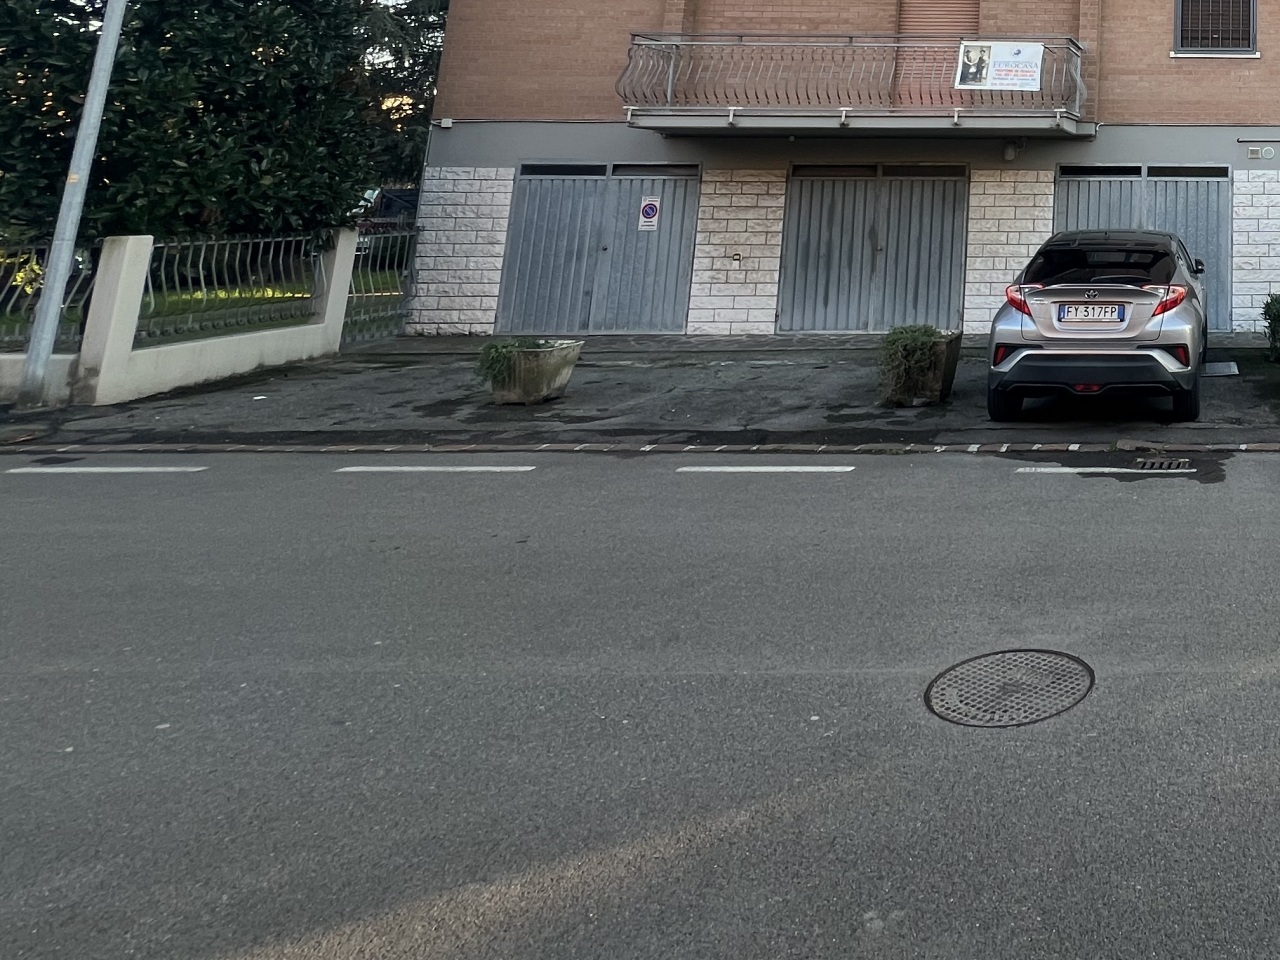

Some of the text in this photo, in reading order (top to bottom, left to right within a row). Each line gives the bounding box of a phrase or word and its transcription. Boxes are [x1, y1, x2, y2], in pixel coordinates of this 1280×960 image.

[993, 61, 1038, 69] EUROCASA
[1067, 306, 1116, 317] FY 317FP
